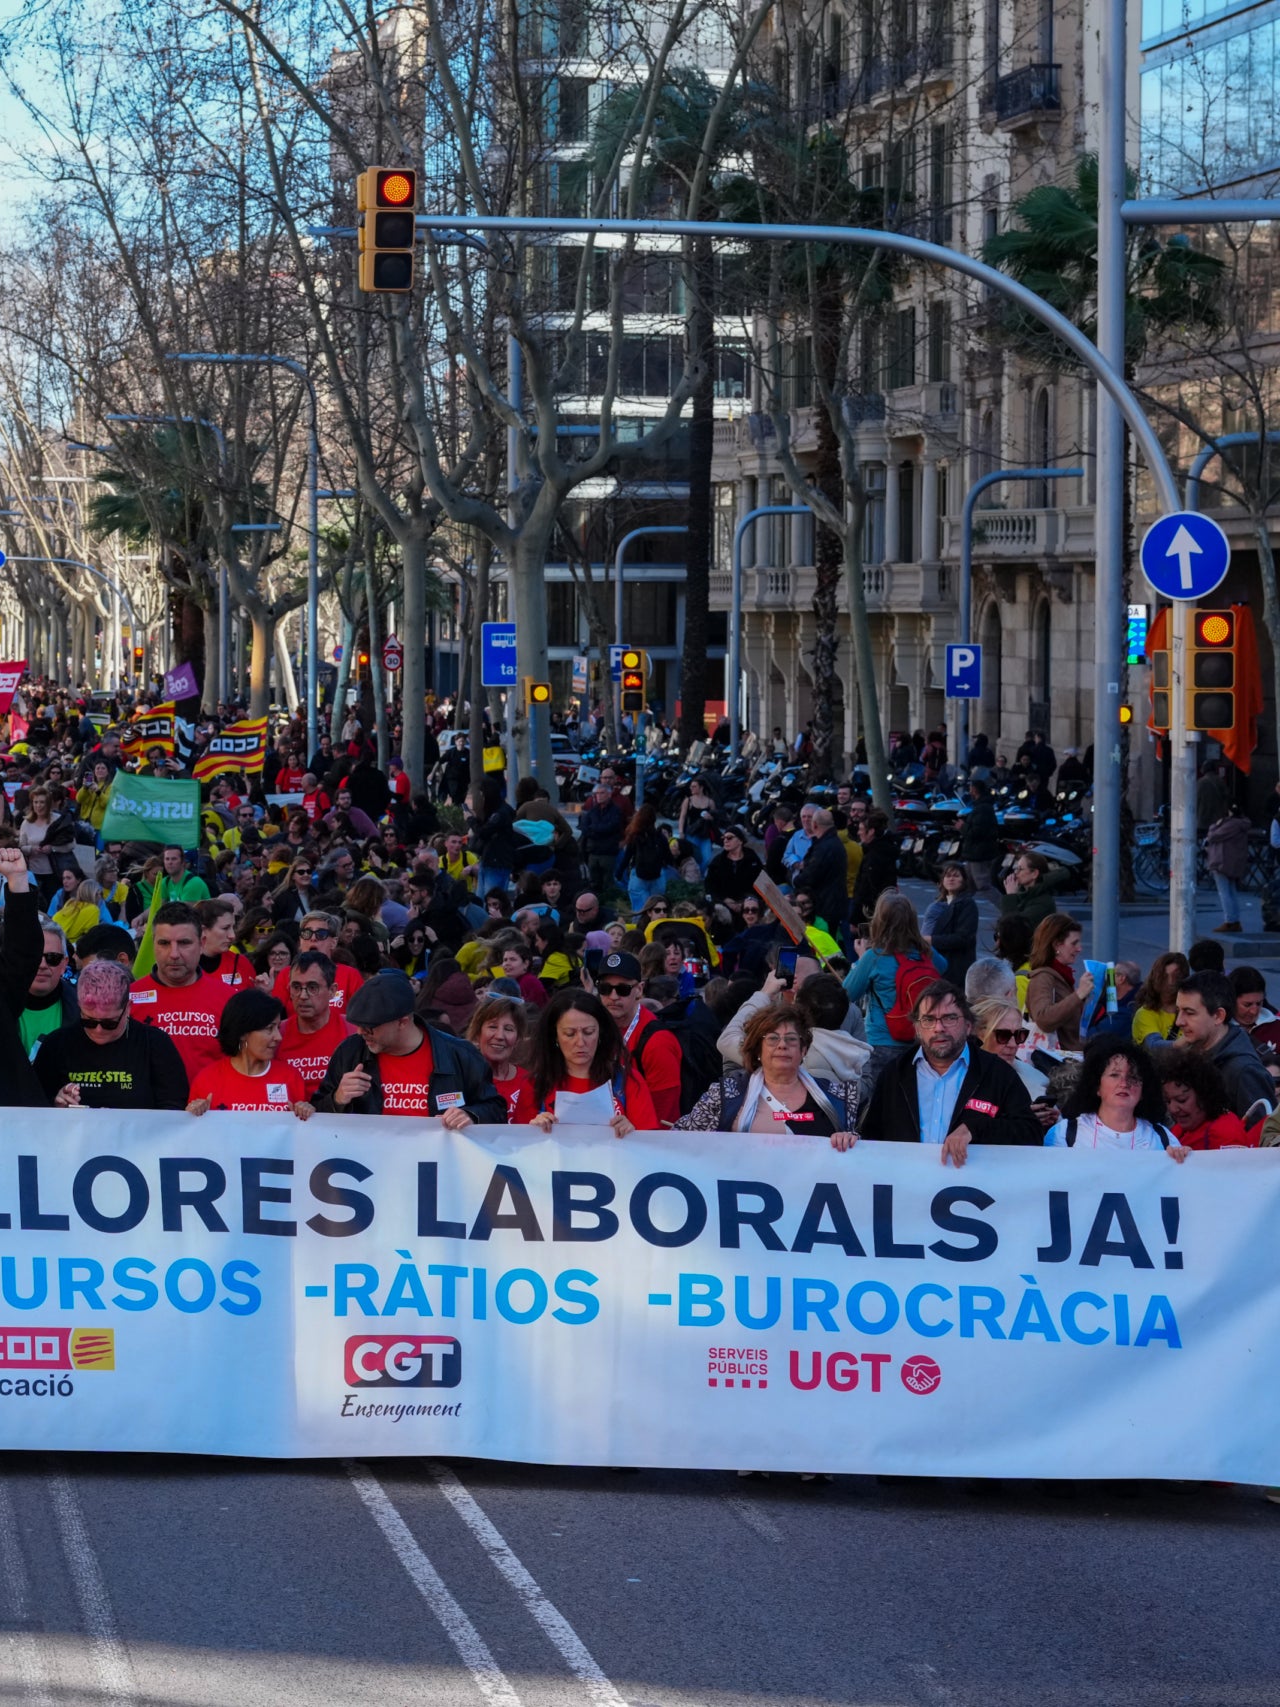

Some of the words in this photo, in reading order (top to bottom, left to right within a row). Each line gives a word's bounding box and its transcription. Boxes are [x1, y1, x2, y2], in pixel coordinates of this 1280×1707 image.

[387, 657, 399, 665] 30
[952, 649, 975, 677] P
[157, 1011, 216, 1024] recursos
[160, 1022, 219, 1037] ducació
[287, 1055, 331, 1068] recurs
[68, 1071, 133, 1083] USTEC·STEs
[383, 1095, 427, 1109] ducac
[975, 1101, 991, 1111] UGT
[786, 1112, 804, 1120] UGT
[417, 1161, 998, 1262] LABORALS
[1037, 1190, 1184, 1270] JA!
[305, 1250, 600, 1325] -RÀTIOS
[648, 1274, 1183, 1350] -BUROCRÀCIA
[352, 1341, 454, 1381] CGT
[708, 1347, 768, 1361] SERVEIS
[708, 1360, 768, 1375] PÚBLICS
[789, 1350, 892, 1393] UGT
[340, 1394, 462, 1423] Ensenyament
